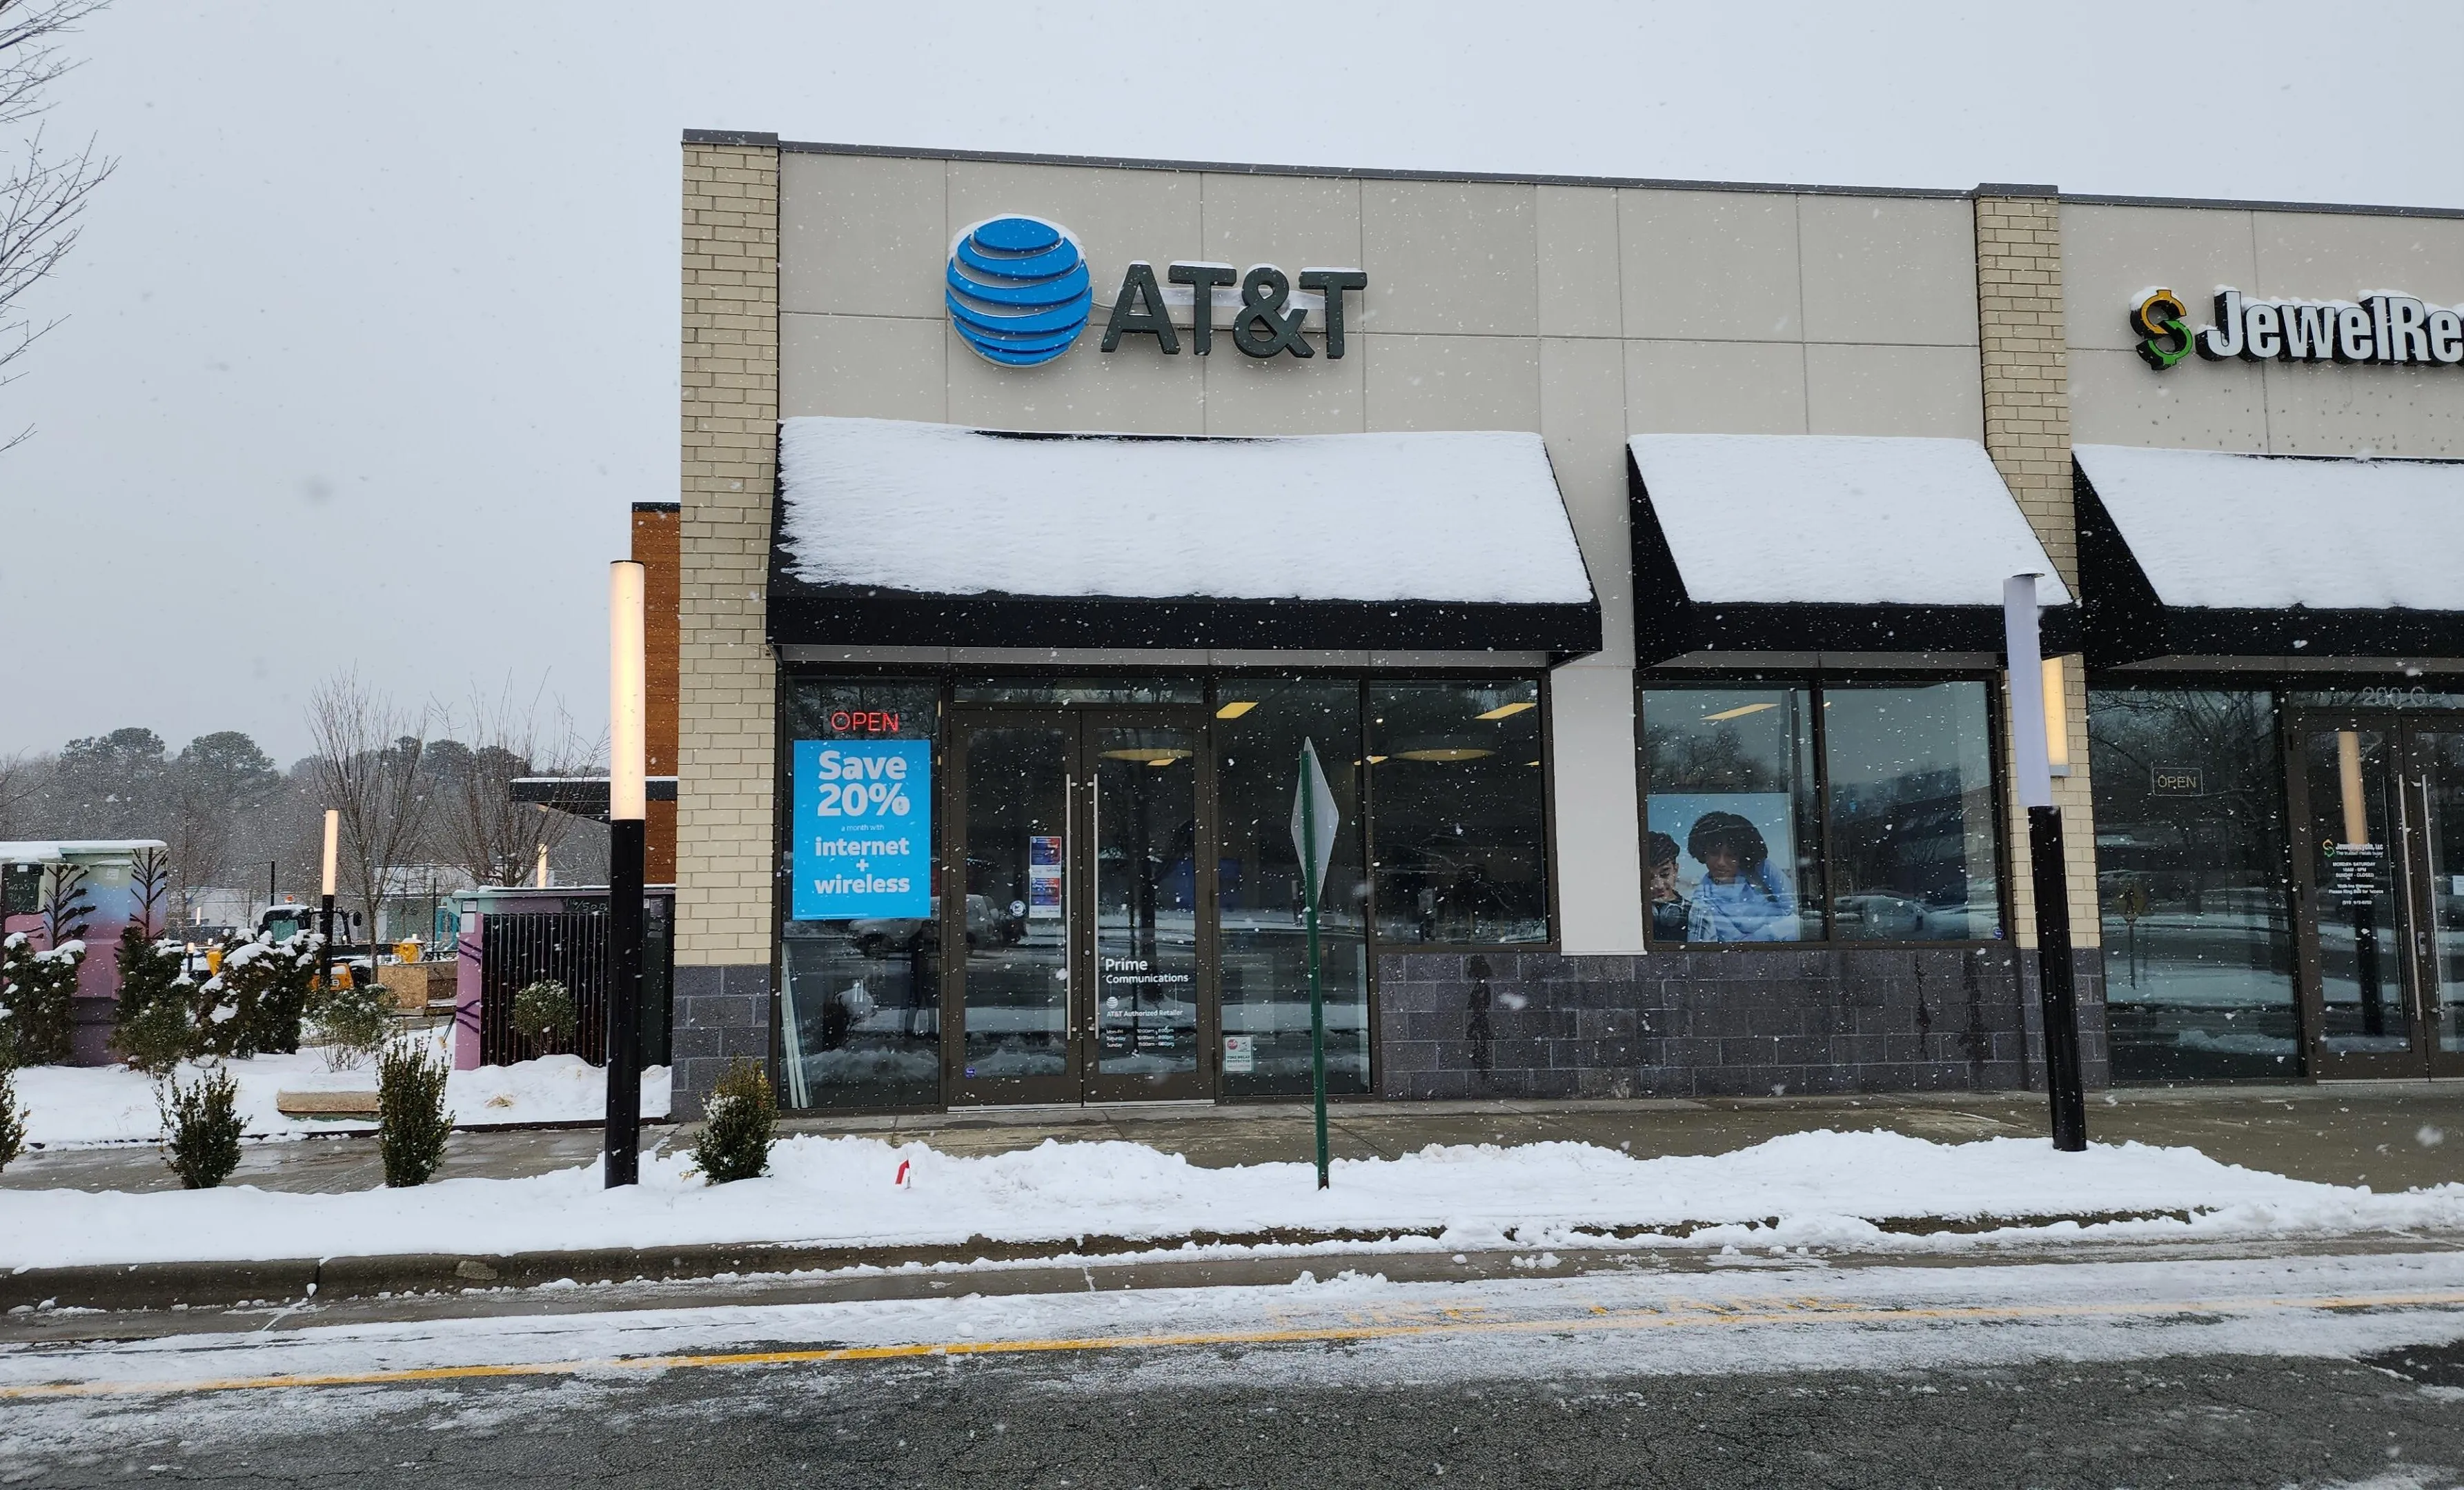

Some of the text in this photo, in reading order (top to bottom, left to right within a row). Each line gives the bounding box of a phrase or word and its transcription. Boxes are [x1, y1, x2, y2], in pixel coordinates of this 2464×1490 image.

[1101, 261, 1368, 359] AT&T
[2363, 686, 2401, 707] 200
[831, 711, 899, 731] OPEN
[818, 750, 907, 780] Save
[2158, 775, 2196, 788] OPEN
[817, 782, 911, 816] 20%
[815, 836, 910, 857] internet
[814, 873, 910, 894] wireless
[1105, 957, 1148, 971] Prime
[1105, 973, 1189, 984] Communications
